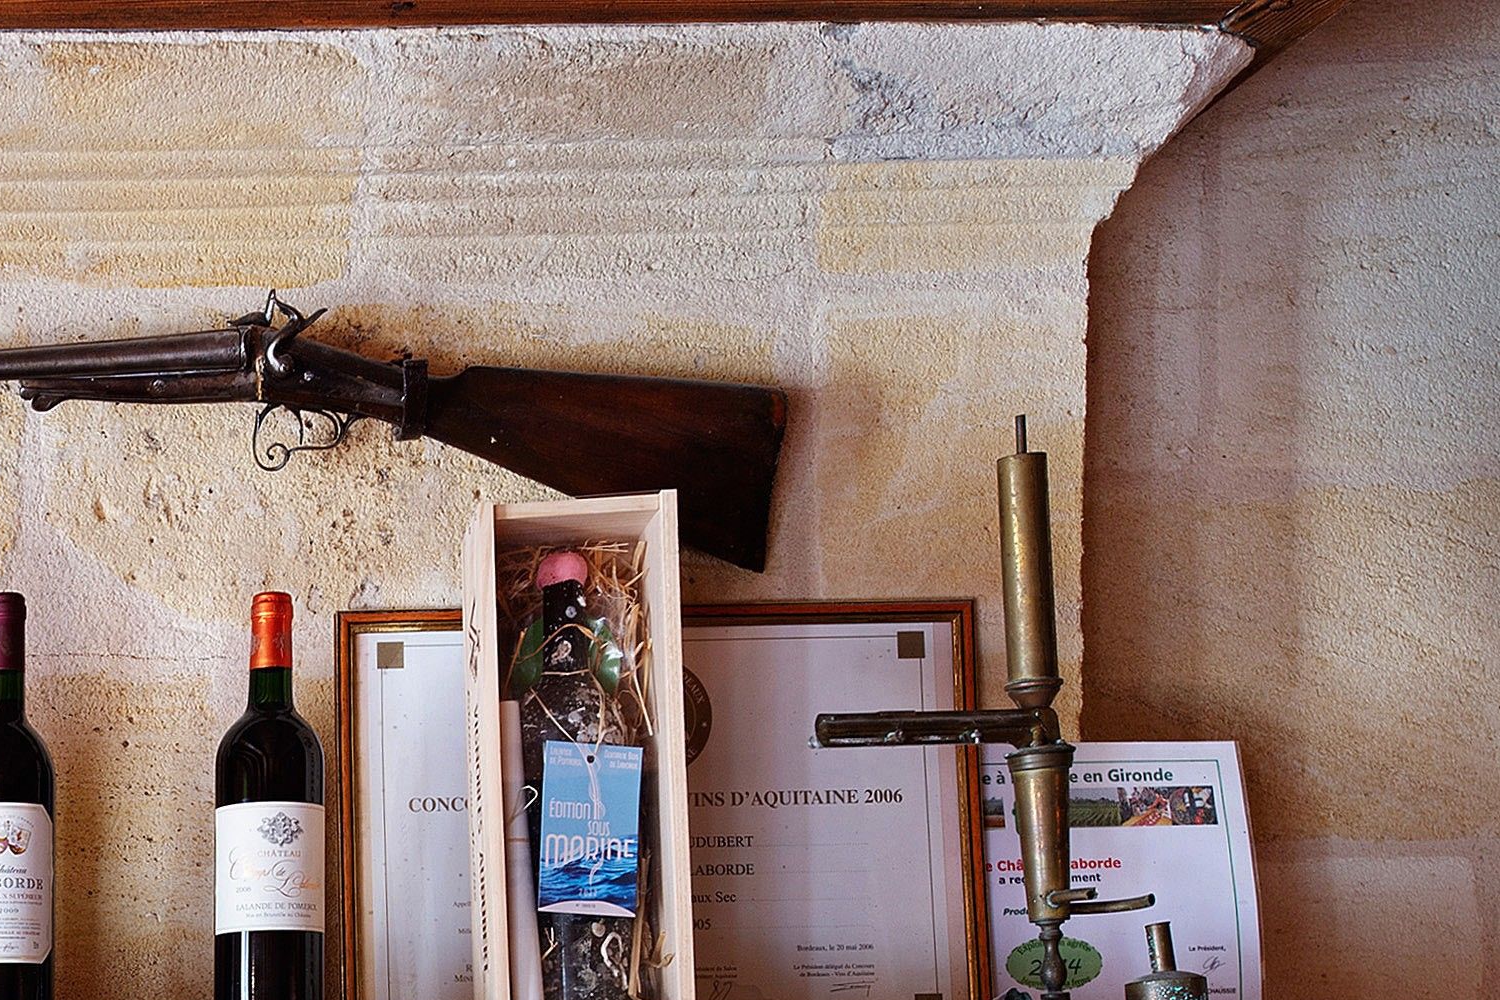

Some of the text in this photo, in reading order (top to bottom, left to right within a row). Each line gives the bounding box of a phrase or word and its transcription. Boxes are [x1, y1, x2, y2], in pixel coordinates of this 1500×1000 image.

[997, 771, 1005, 784] à
[1084, 774, 1103, 782] en
[1108, 769, 1174, 782] Gironde
[865, 788, 903, 804] 2006
[549, 798, 591, 820] ÉDITION
[691, 863, 755, 876] ABORDE
[715, 890, 737, 904] Sec
